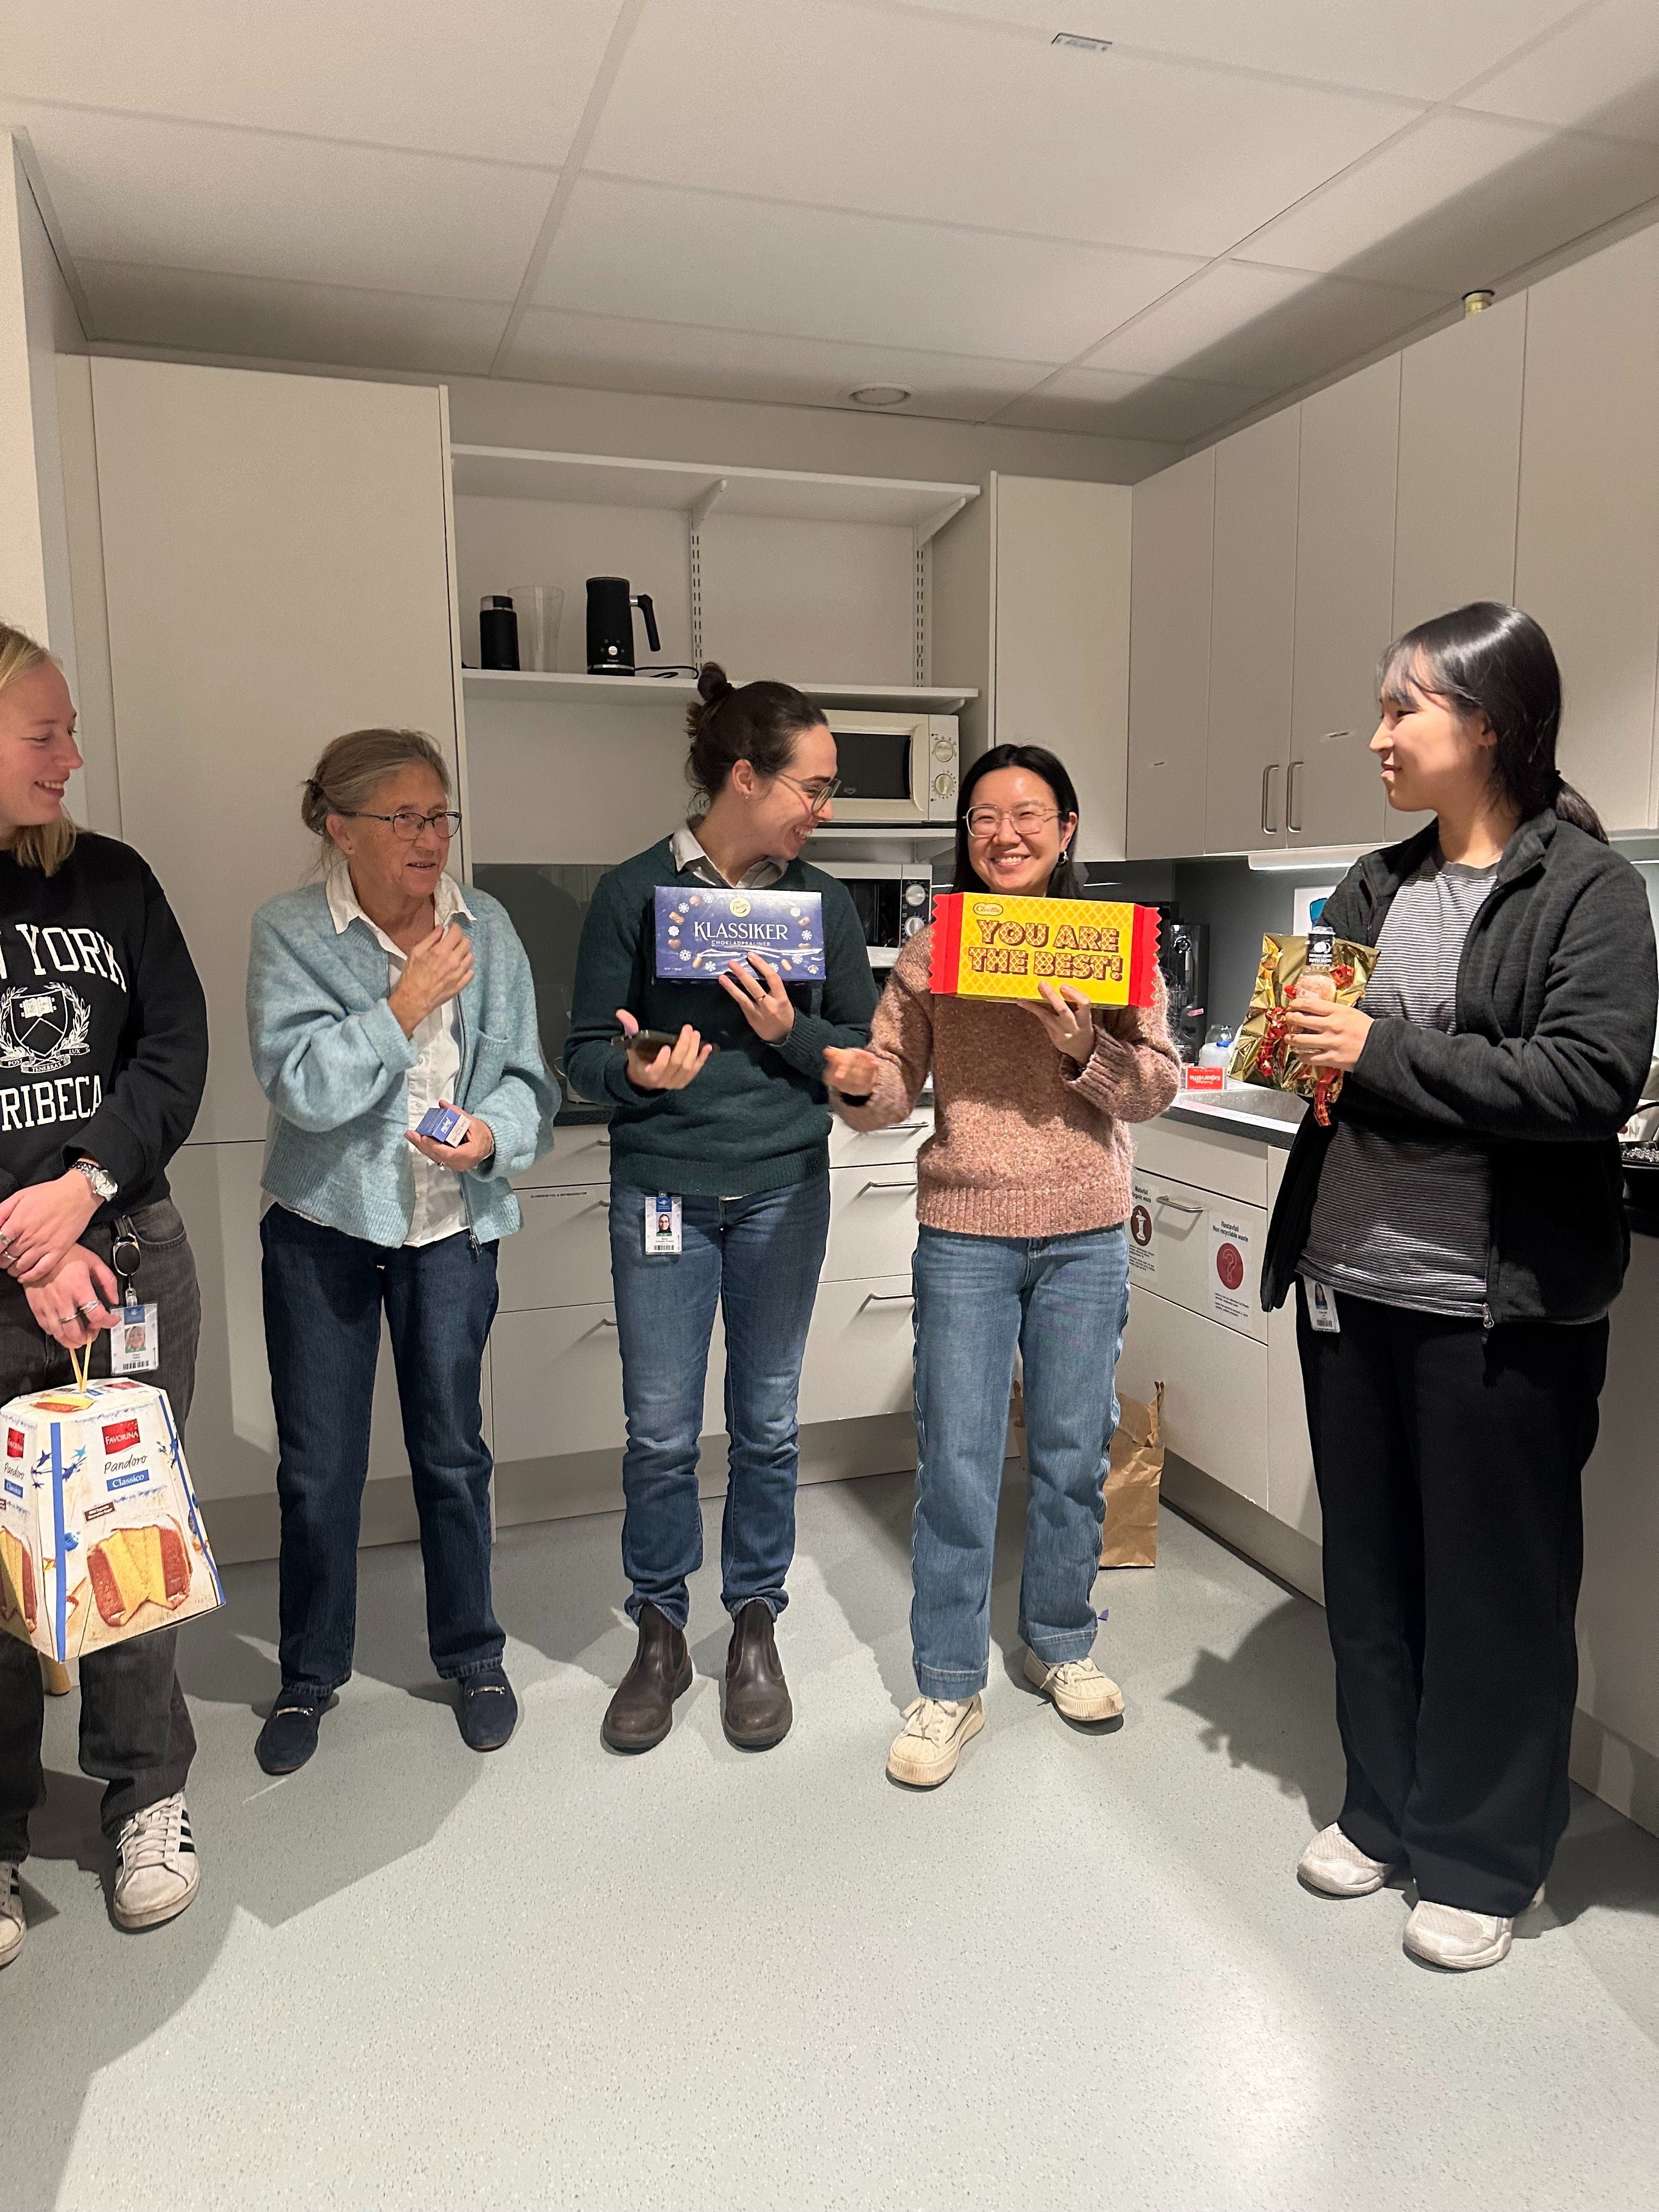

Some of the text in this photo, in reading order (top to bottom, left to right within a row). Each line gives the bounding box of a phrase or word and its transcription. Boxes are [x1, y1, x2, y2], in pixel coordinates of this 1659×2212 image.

[976, 905, 1000, 913] Cloetta
[694, 921, 788, 940] KLASSIKER
[977, 919, 1120, 952] YOU ARE
[15, 923, 127, 993] YORK
[968, 947, 1123, 981] THE BEST!
[31, 1062, 63, 1073] TENEBRAS
[0, 1075, 103, 1131] RIBECA
[104, 1454, 148, 1475] Pandoro
[112, 1474, 145, 1488] Classico
